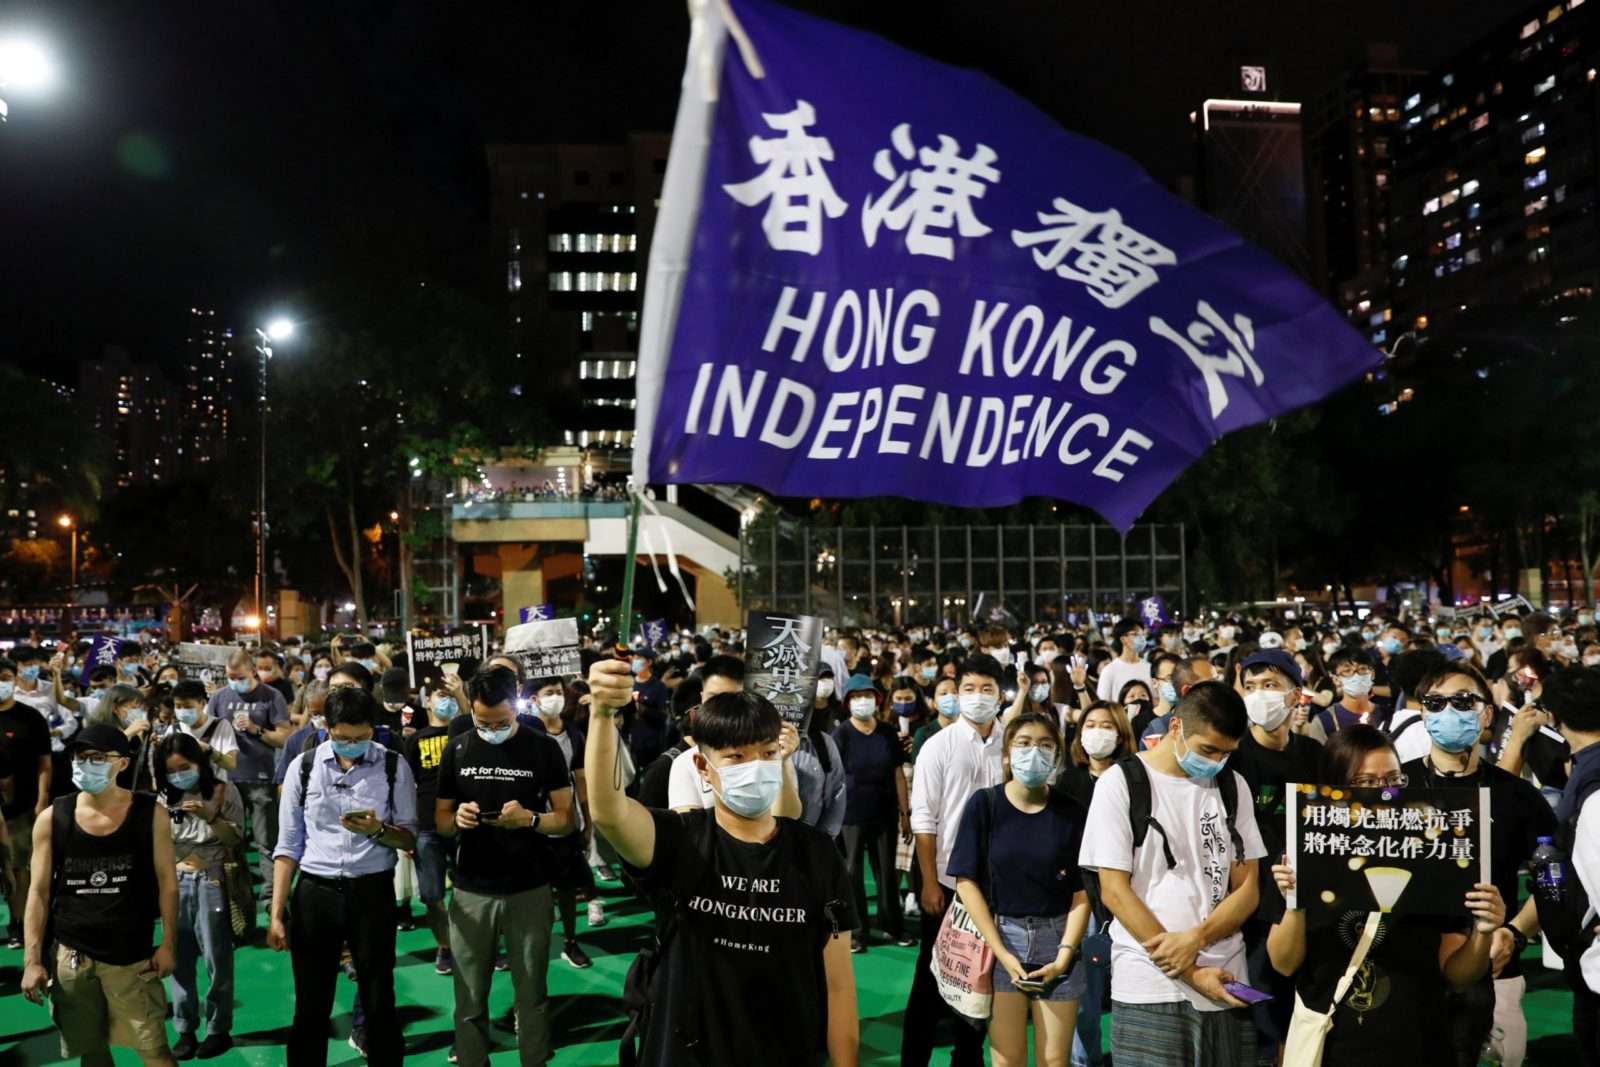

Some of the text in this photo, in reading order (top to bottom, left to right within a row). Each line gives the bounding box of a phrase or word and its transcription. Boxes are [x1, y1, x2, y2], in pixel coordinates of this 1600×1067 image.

[761, 286, 1137, 396] HONG KONG
[684, 361, 1154, 483] INDEPENDENCE
[460, 766, 477, 777] ight
[479, 766, 494, 776] for
[1304, 804, 1475, 832] 用燭光點燃抗爭
[1303, 831, 1475, 860] 將悼念化作力量
[721, 874, 781, 893] WE ARE
